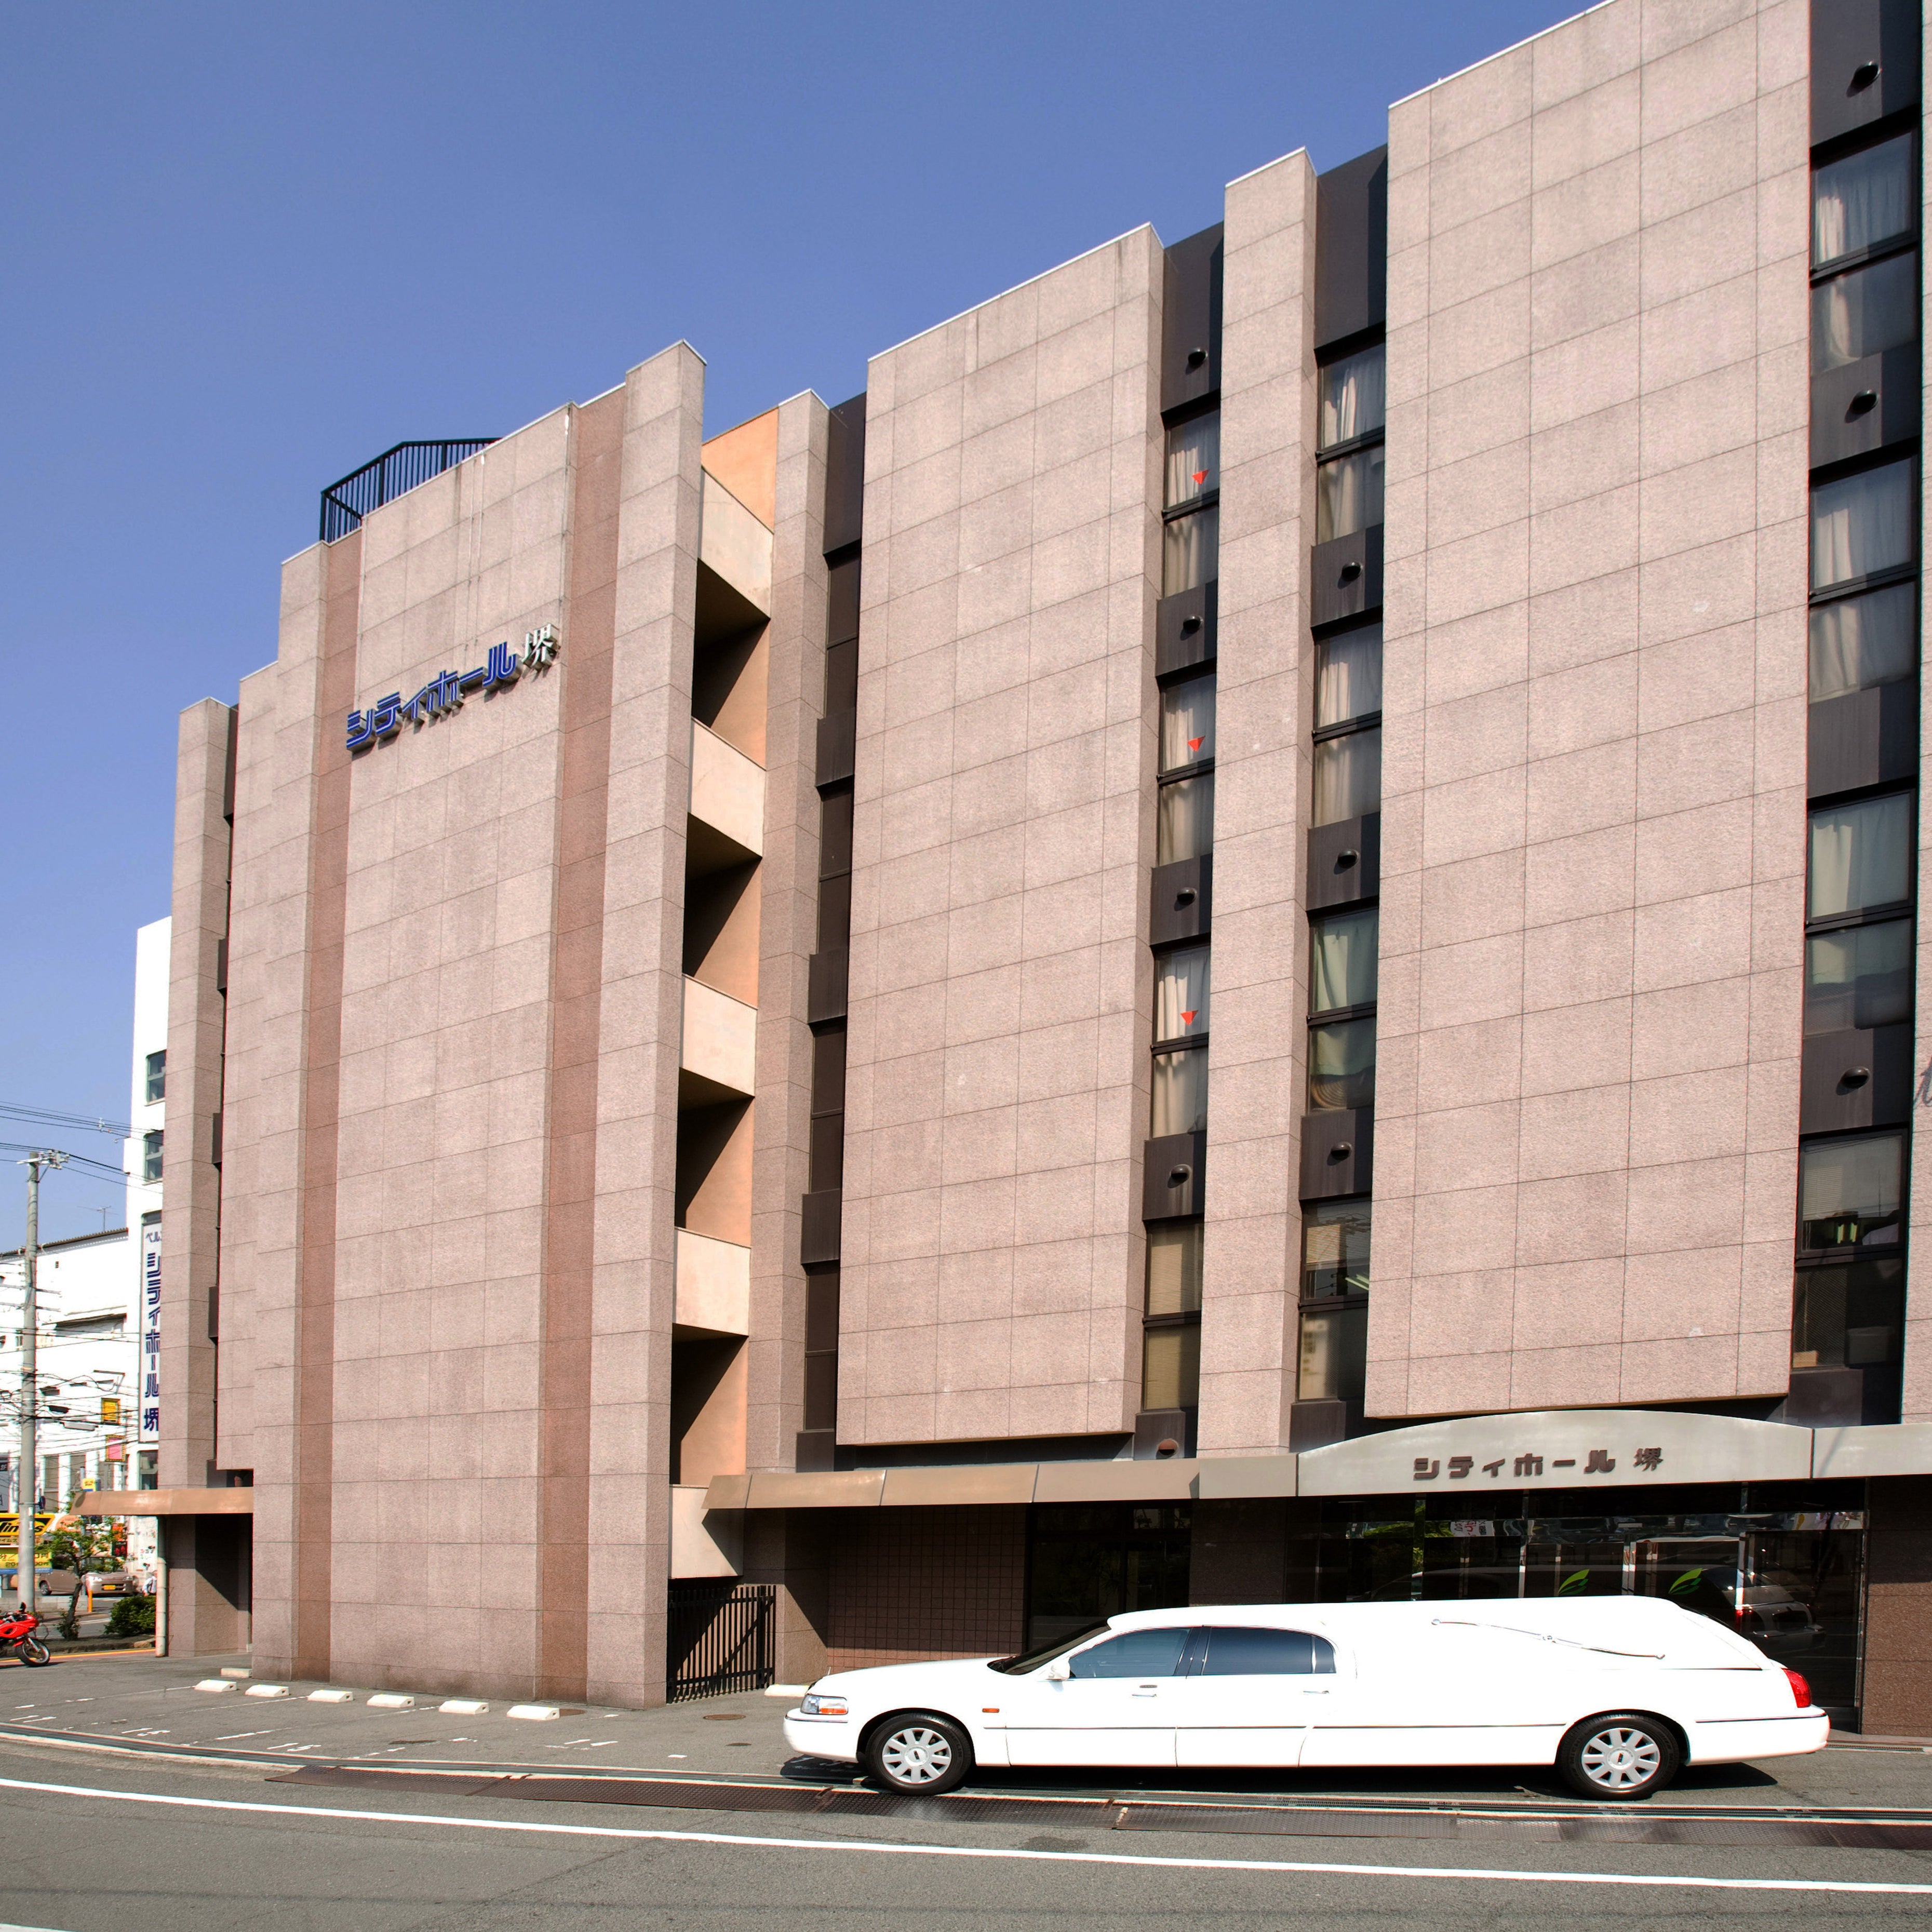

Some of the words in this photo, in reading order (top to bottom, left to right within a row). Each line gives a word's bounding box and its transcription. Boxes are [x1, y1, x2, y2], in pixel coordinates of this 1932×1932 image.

[1414, 1447, 1664, 1480] シティホール堺
